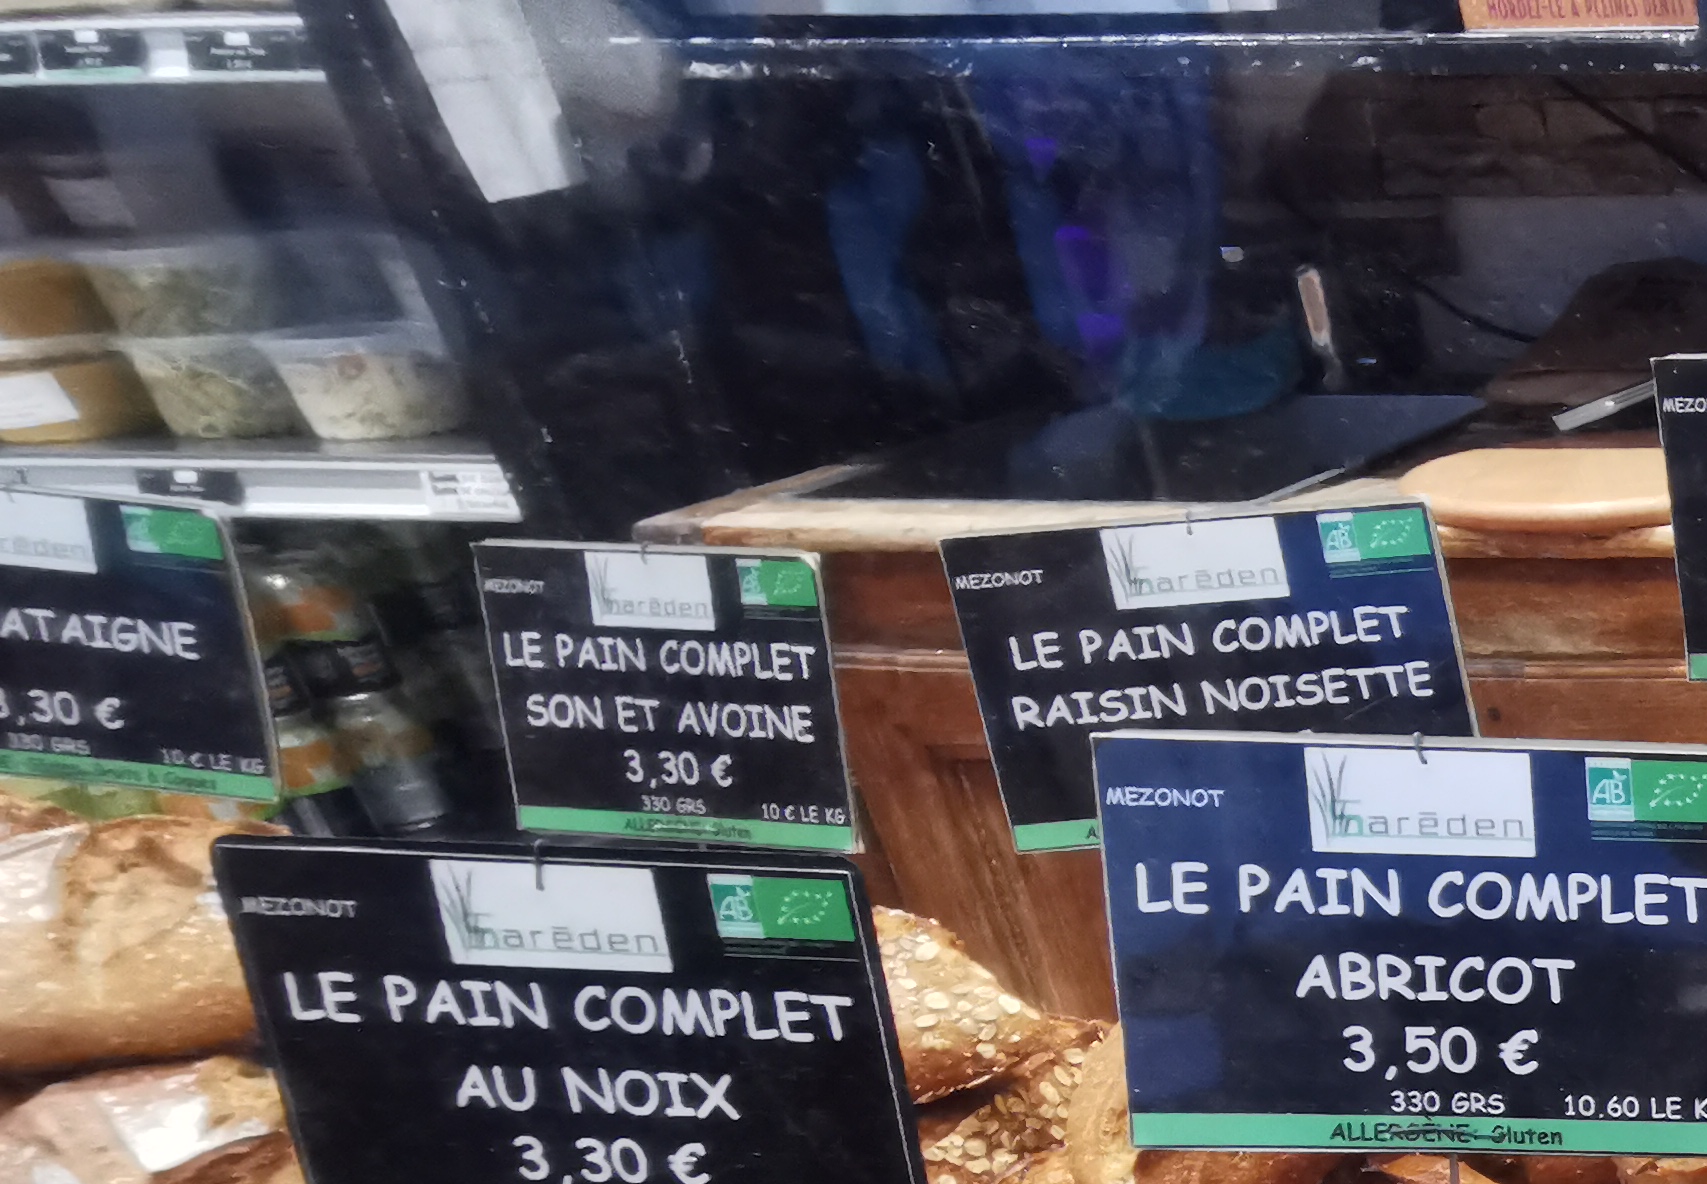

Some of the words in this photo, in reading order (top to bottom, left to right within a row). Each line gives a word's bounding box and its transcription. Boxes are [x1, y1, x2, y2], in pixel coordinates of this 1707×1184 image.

[954, 569, 1044, 591] MEZONOT
[1, 607, 201, 661] ATAIGNE
[503, 631, 545, 669] LE
[555, 632, 648, 673] PAIN
[659, 639, 817, 681] COMPLET
[1008, 632, 1063, 671] LE
[1078, 622, 1196, 664] PAIN
[1212, 604, 1409, 653] COMPLET
[95, 697, 125, 730] €
[527, 694, 605, 729] SON
[614, 695, 660, 734] ET
[678, 701, 816, 744] AVOINE
[1011, 683, 1188, 731] RAISIN
[1200, 660, 1434, 717] NOISETTE
[623, 749, 700, 789] 3,30
[710, 753, 734, 787] €
[1591, 778, 1626, 805] AB
[641, 795, 672, 812] 330
[761, 802, 779, 820] 10
[784, 804, 796, 821] €
[800, 805, 819, 823] LE
[825, 807, 846, 825] KG
[1105, 786, 1225, 809] MEZONOT
[1135, 862, 1210, 916] LE
[1238, 863, 1402, 918] PAIN
[1295, 951, 1577, 1006] ABRICOT
[284, 970, 362, 1024] LE
[385, 974, 550, 1031] PAIN
[575, 986, 855, 1043] COMPLET
[1342, 1024, 1478, 1081] 3,50
[1498, 1027, 1539, 1076] €
[456, 1066, 536, 1111] AU
[562, 1066, 742, 1122] NOIX
[1389, 1090, 1442, 1113] 330
[1451, 1091, 1507, 1115] GRS
[1563, 1095, 1641, 1121] 10.60
[1650, 1096, 1683, 1119] LE
